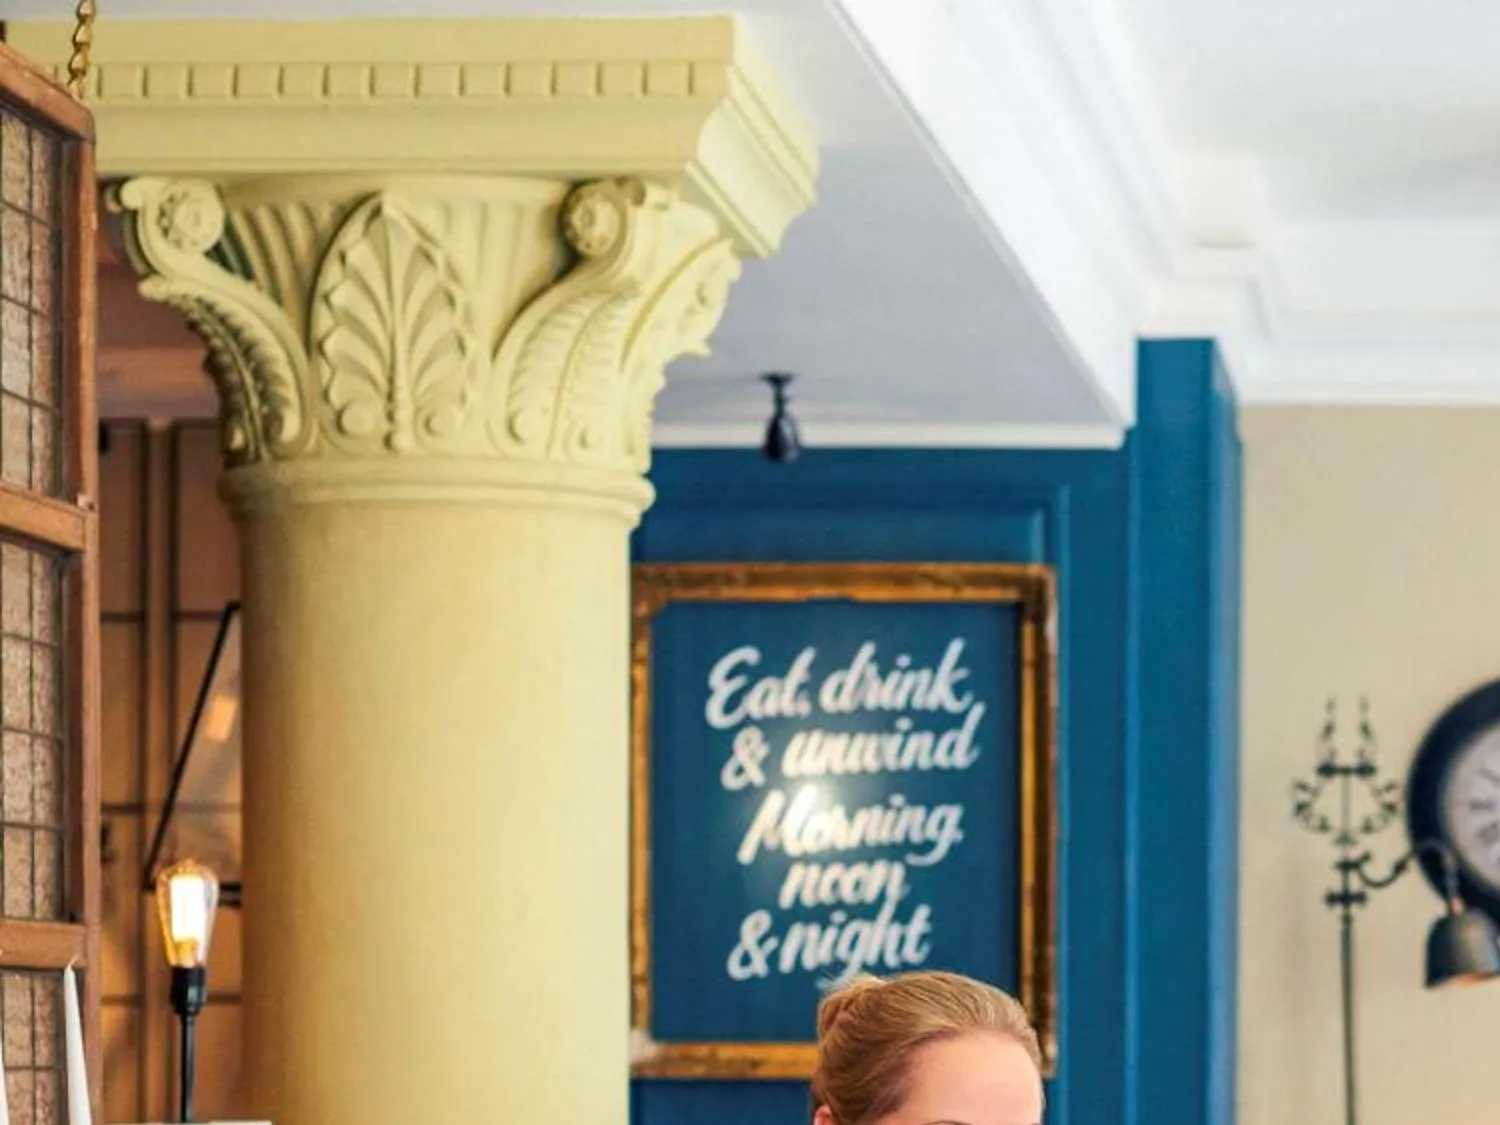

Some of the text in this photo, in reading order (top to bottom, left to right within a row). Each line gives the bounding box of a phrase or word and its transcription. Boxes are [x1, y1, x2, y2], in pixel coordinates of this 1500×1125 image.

[720, 701, 986, 791] & unwind
[737, 784, 965, 866] Morning
[778, 859, 910, 910] noon
[726, 902, 934, 990] & night
